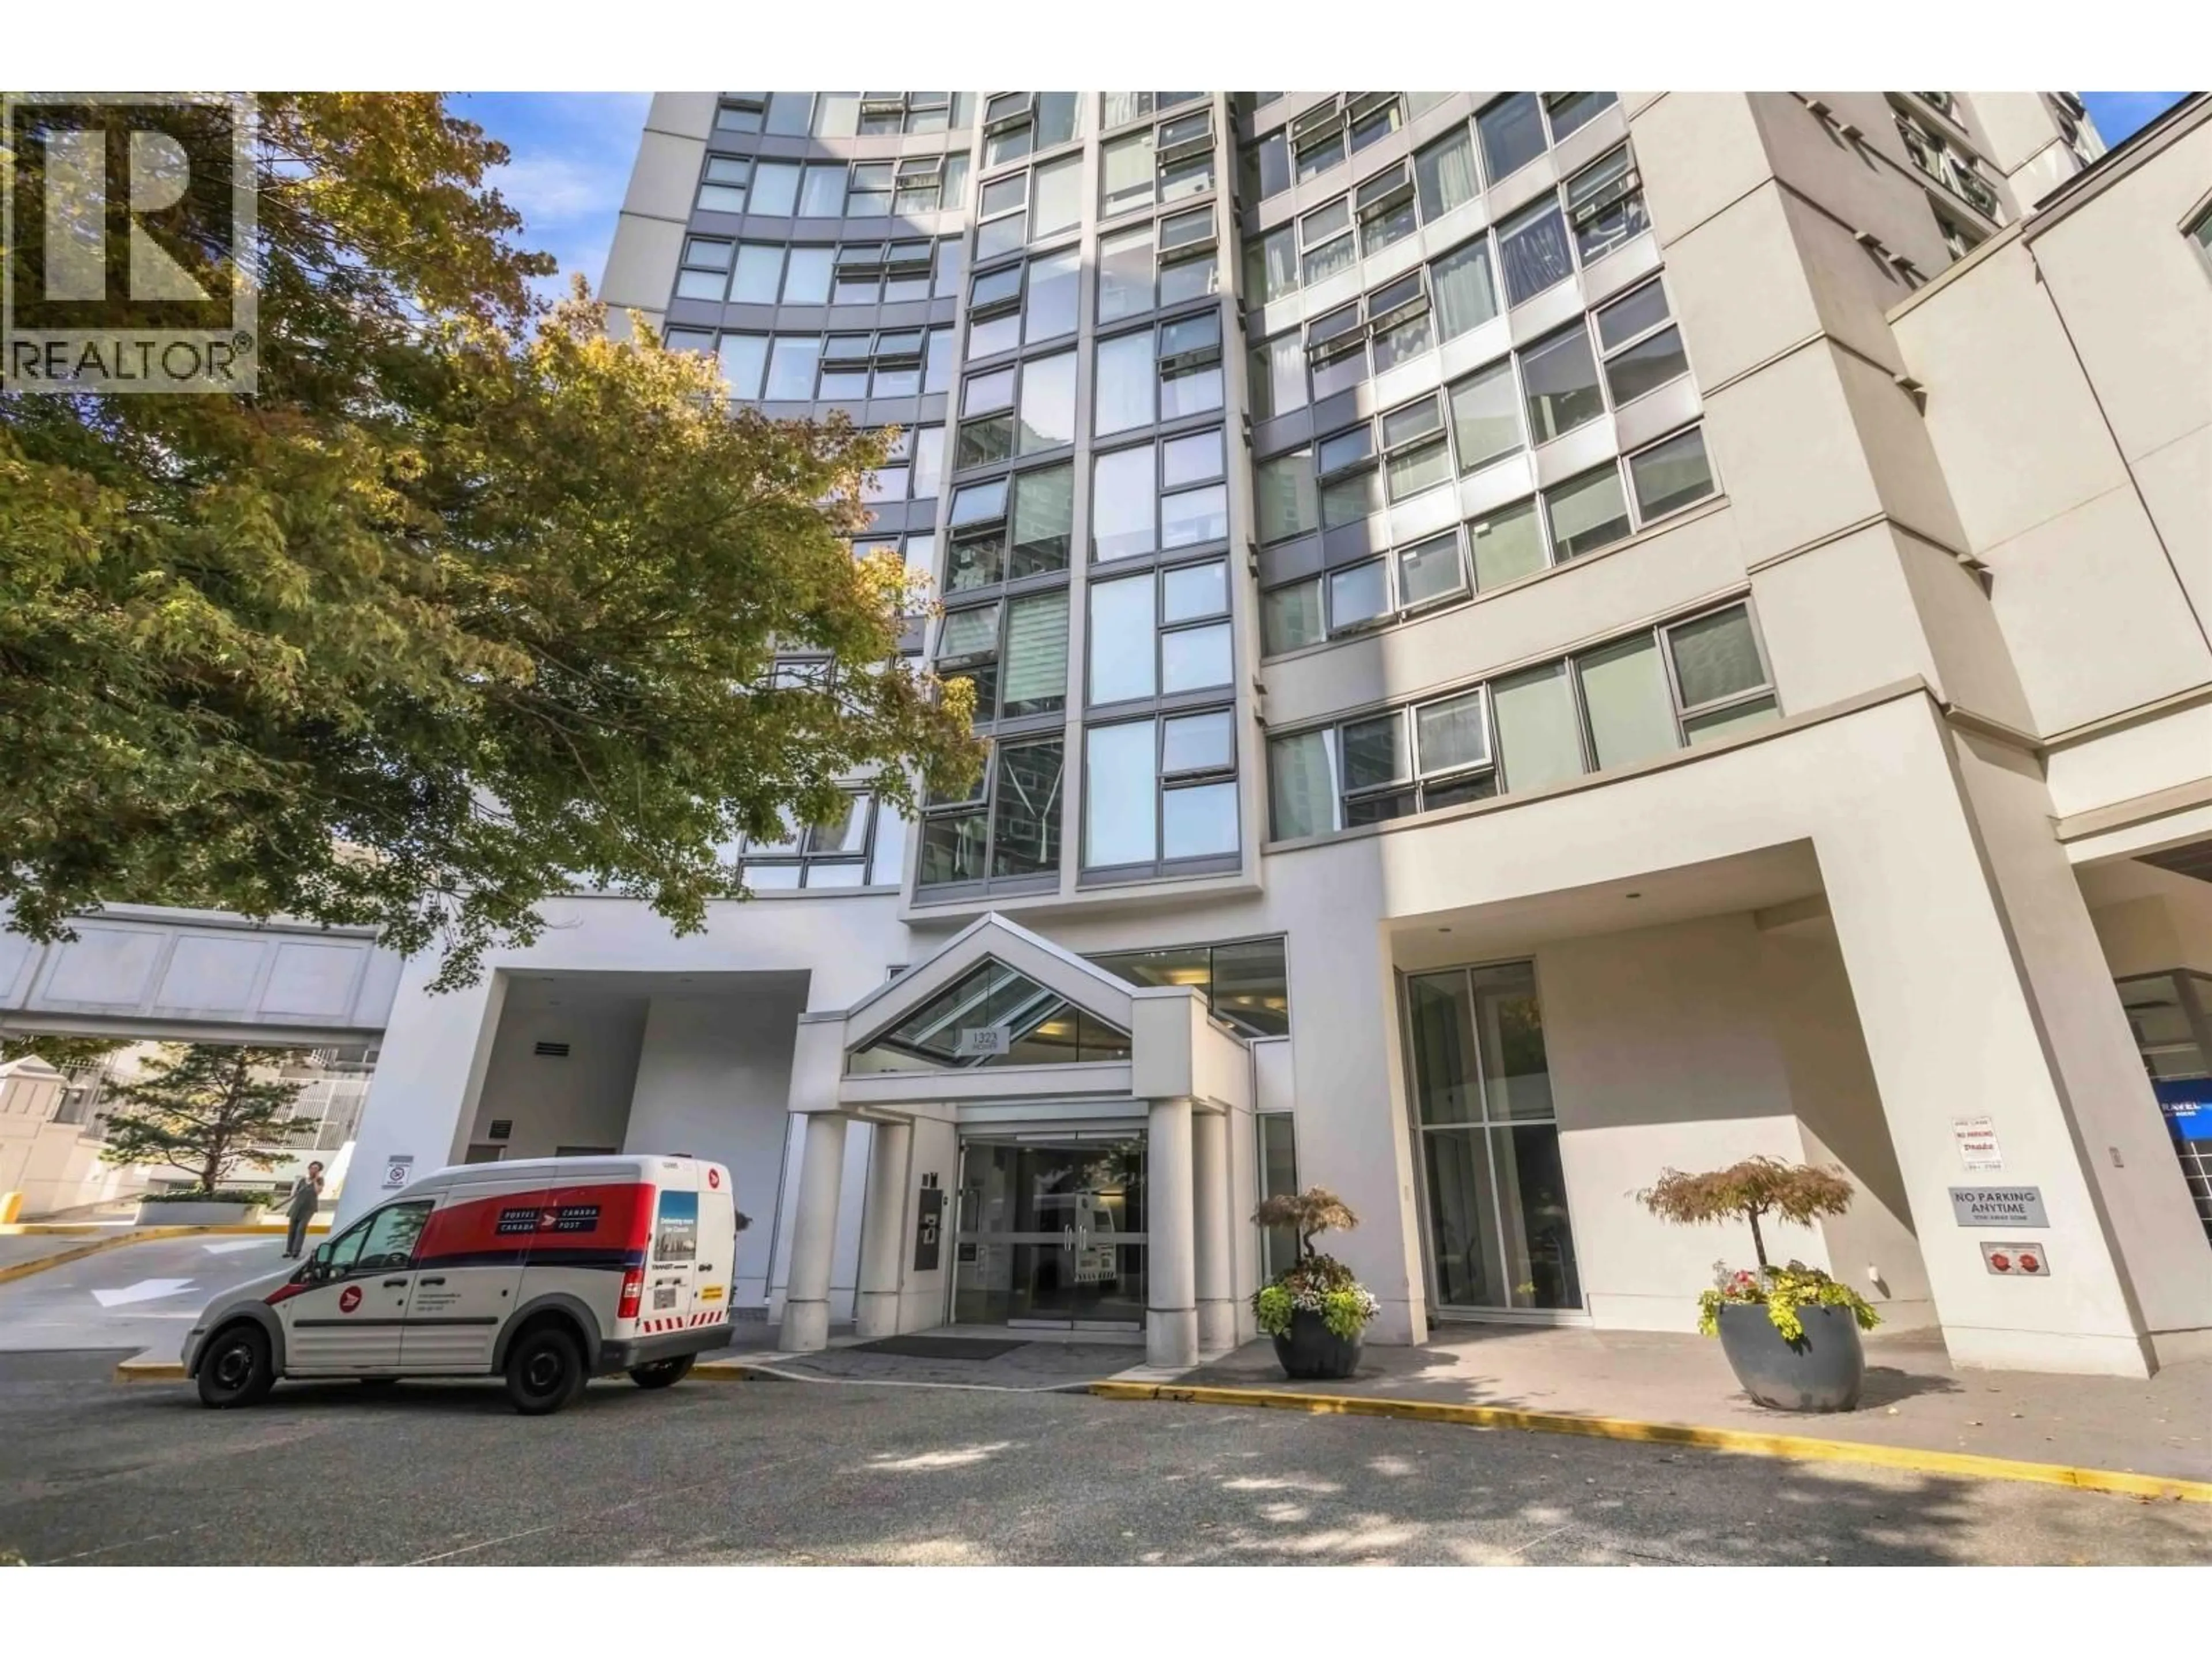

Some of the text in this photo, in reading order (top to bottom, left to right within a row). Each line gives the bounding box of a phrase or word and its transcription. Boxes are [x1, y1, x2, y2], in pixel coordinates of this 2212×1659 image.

[1955, 1192, 2036, 1202] NO PARKING
[1971, 1203, 2026, 1213] ANYTIME
[562, 1209, 597, 1217] CANADA
[501, 1224, 534, 1232] CANADA
[558, 1221, 581, 1229] POST
